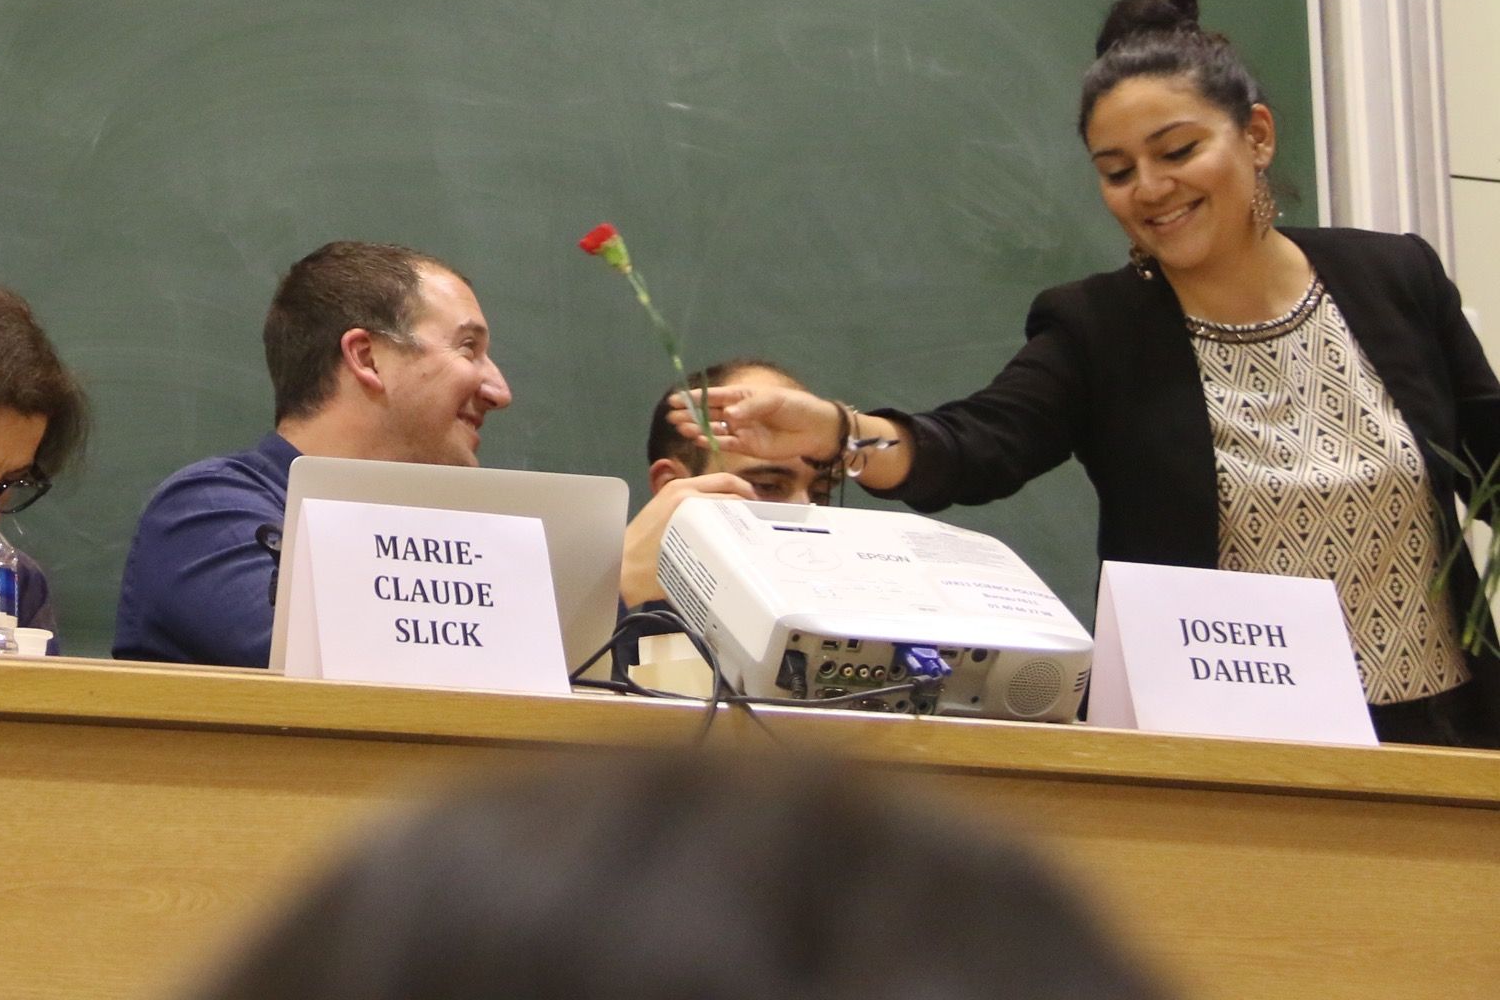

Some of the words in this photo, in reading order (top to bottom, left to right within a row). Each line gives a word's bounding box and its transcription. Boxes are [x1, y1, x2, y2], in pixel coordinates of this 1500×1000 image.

[373, 534, 483, 566] MARIE-
[856, 552, 910, 563] EPSON
[373, 575, 494, 608] CLAUDE
[394, 617, 483, 648] SLICK
[1179, 618, 1288, 648] JOSEPH
[1189, 657, 1296, 686] DAHER
